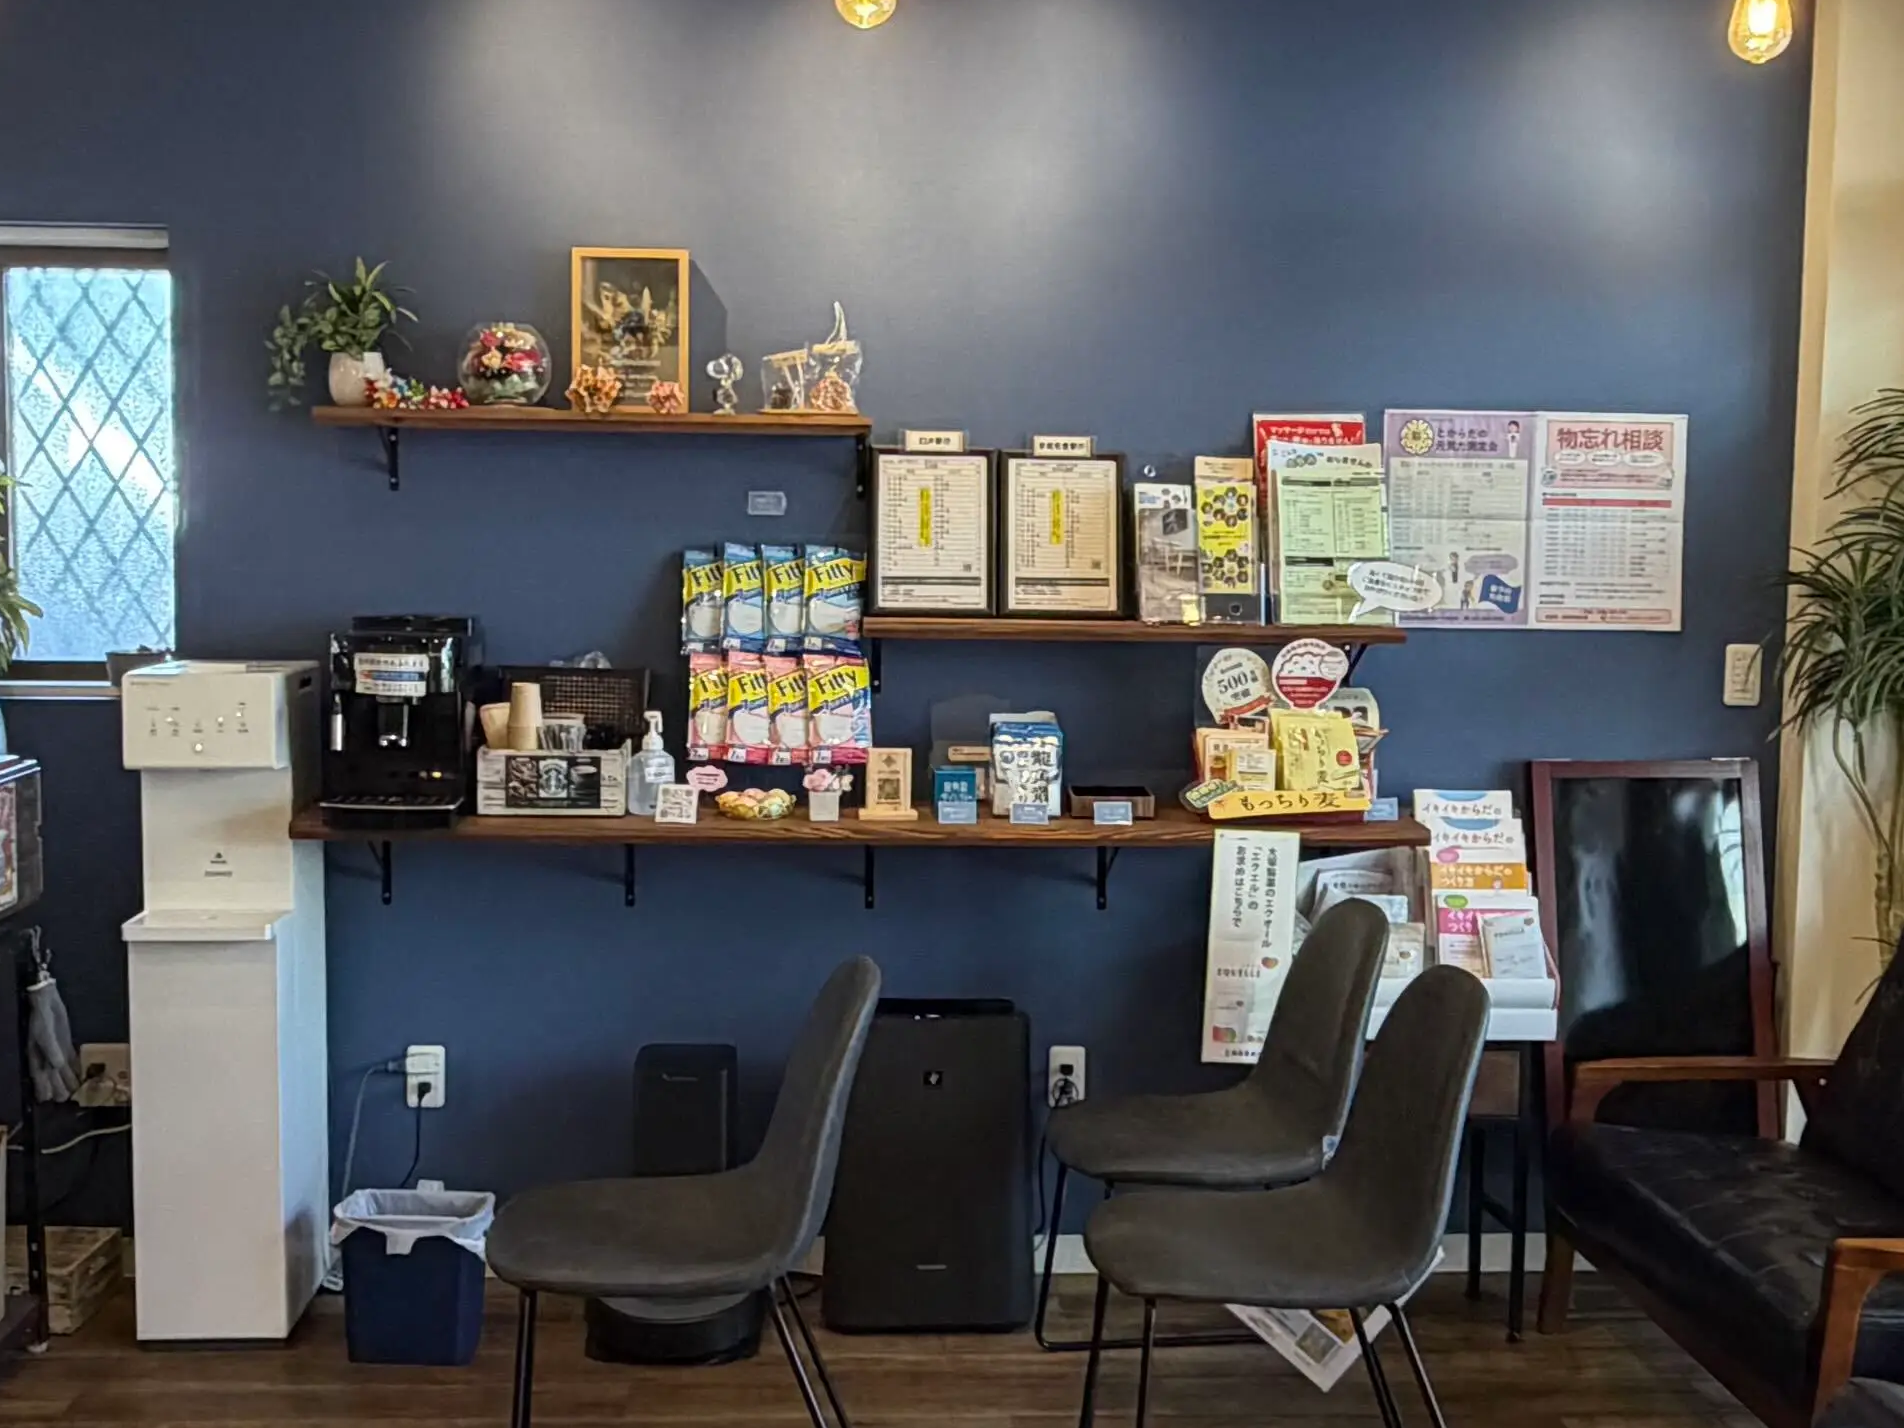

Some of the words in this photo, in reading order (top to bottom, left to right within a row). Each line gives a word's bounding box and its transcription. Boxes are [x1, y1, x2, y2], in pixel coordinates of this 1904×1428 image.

[1557, 427, 1665, 451] 物忘れ相談
[1217, 672, 1249, 695] 500
